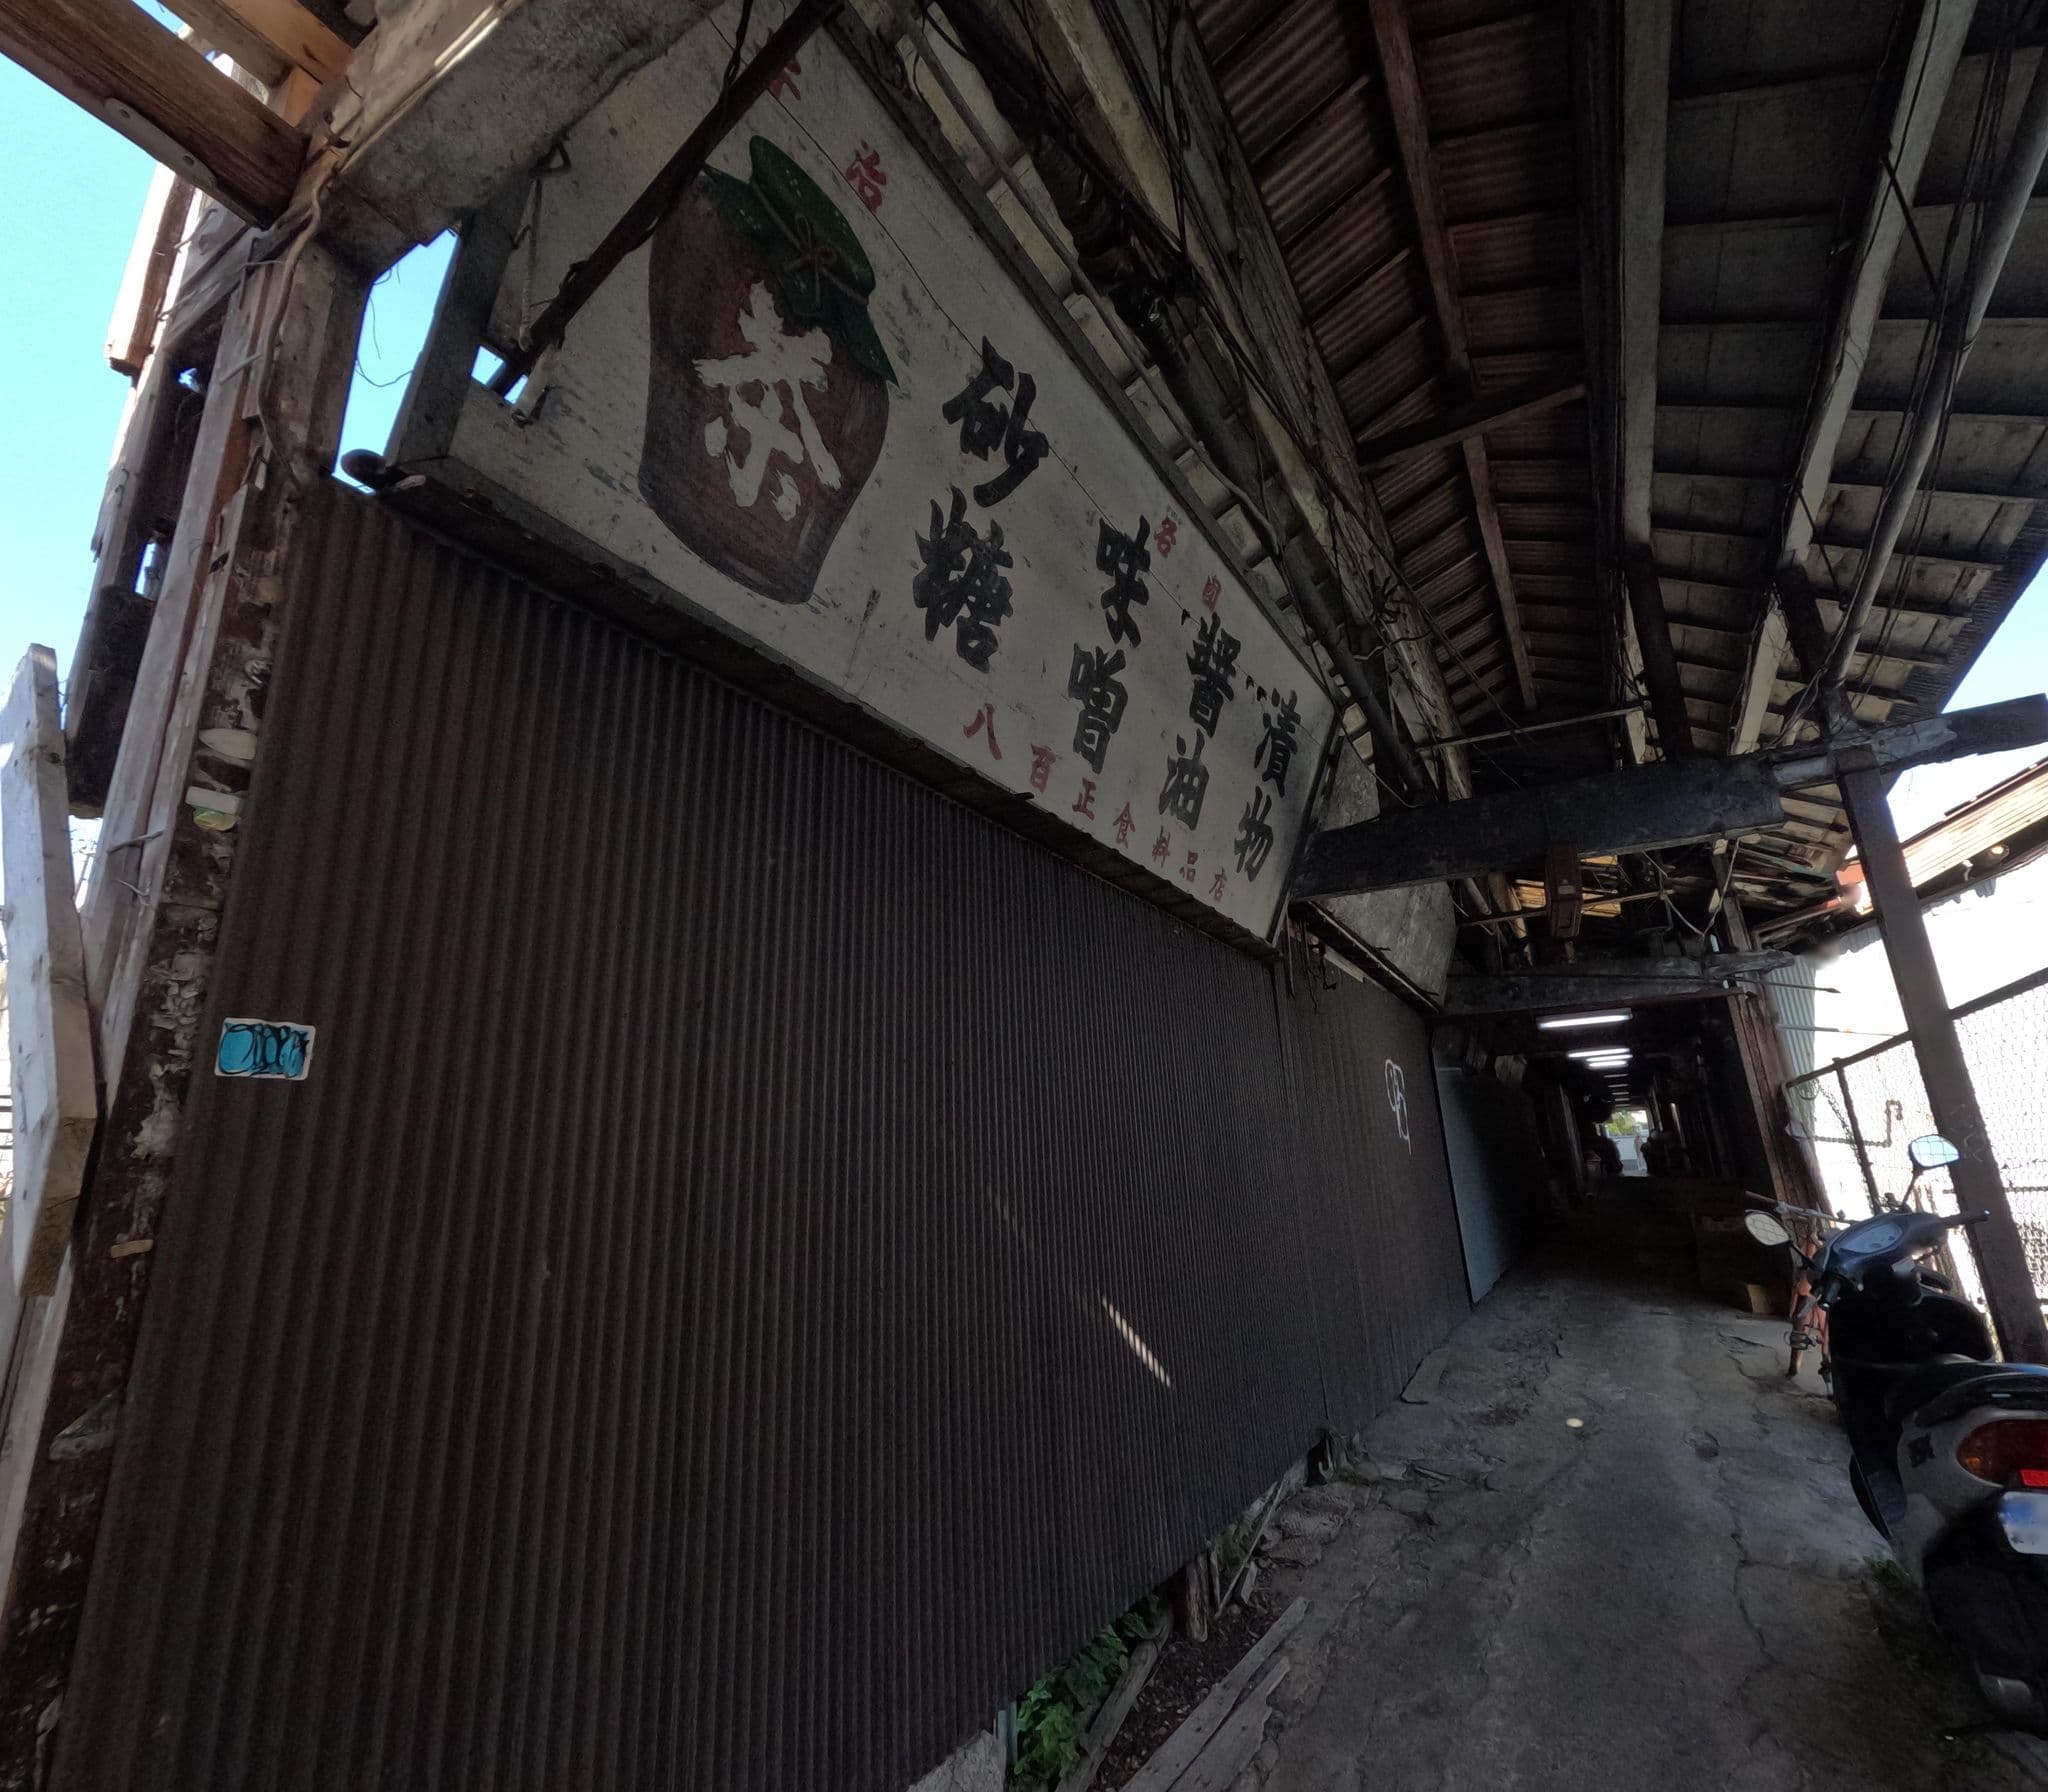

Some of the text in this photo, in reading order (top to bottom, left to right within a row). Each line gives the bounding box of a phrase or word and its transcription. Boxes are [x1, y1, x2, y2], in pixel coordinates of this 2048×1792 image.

[693, 280, 842, 522] 茶
[912, 337, 1049, 673] 砂糖
[1234, 688, 1301, 882] 漬物
